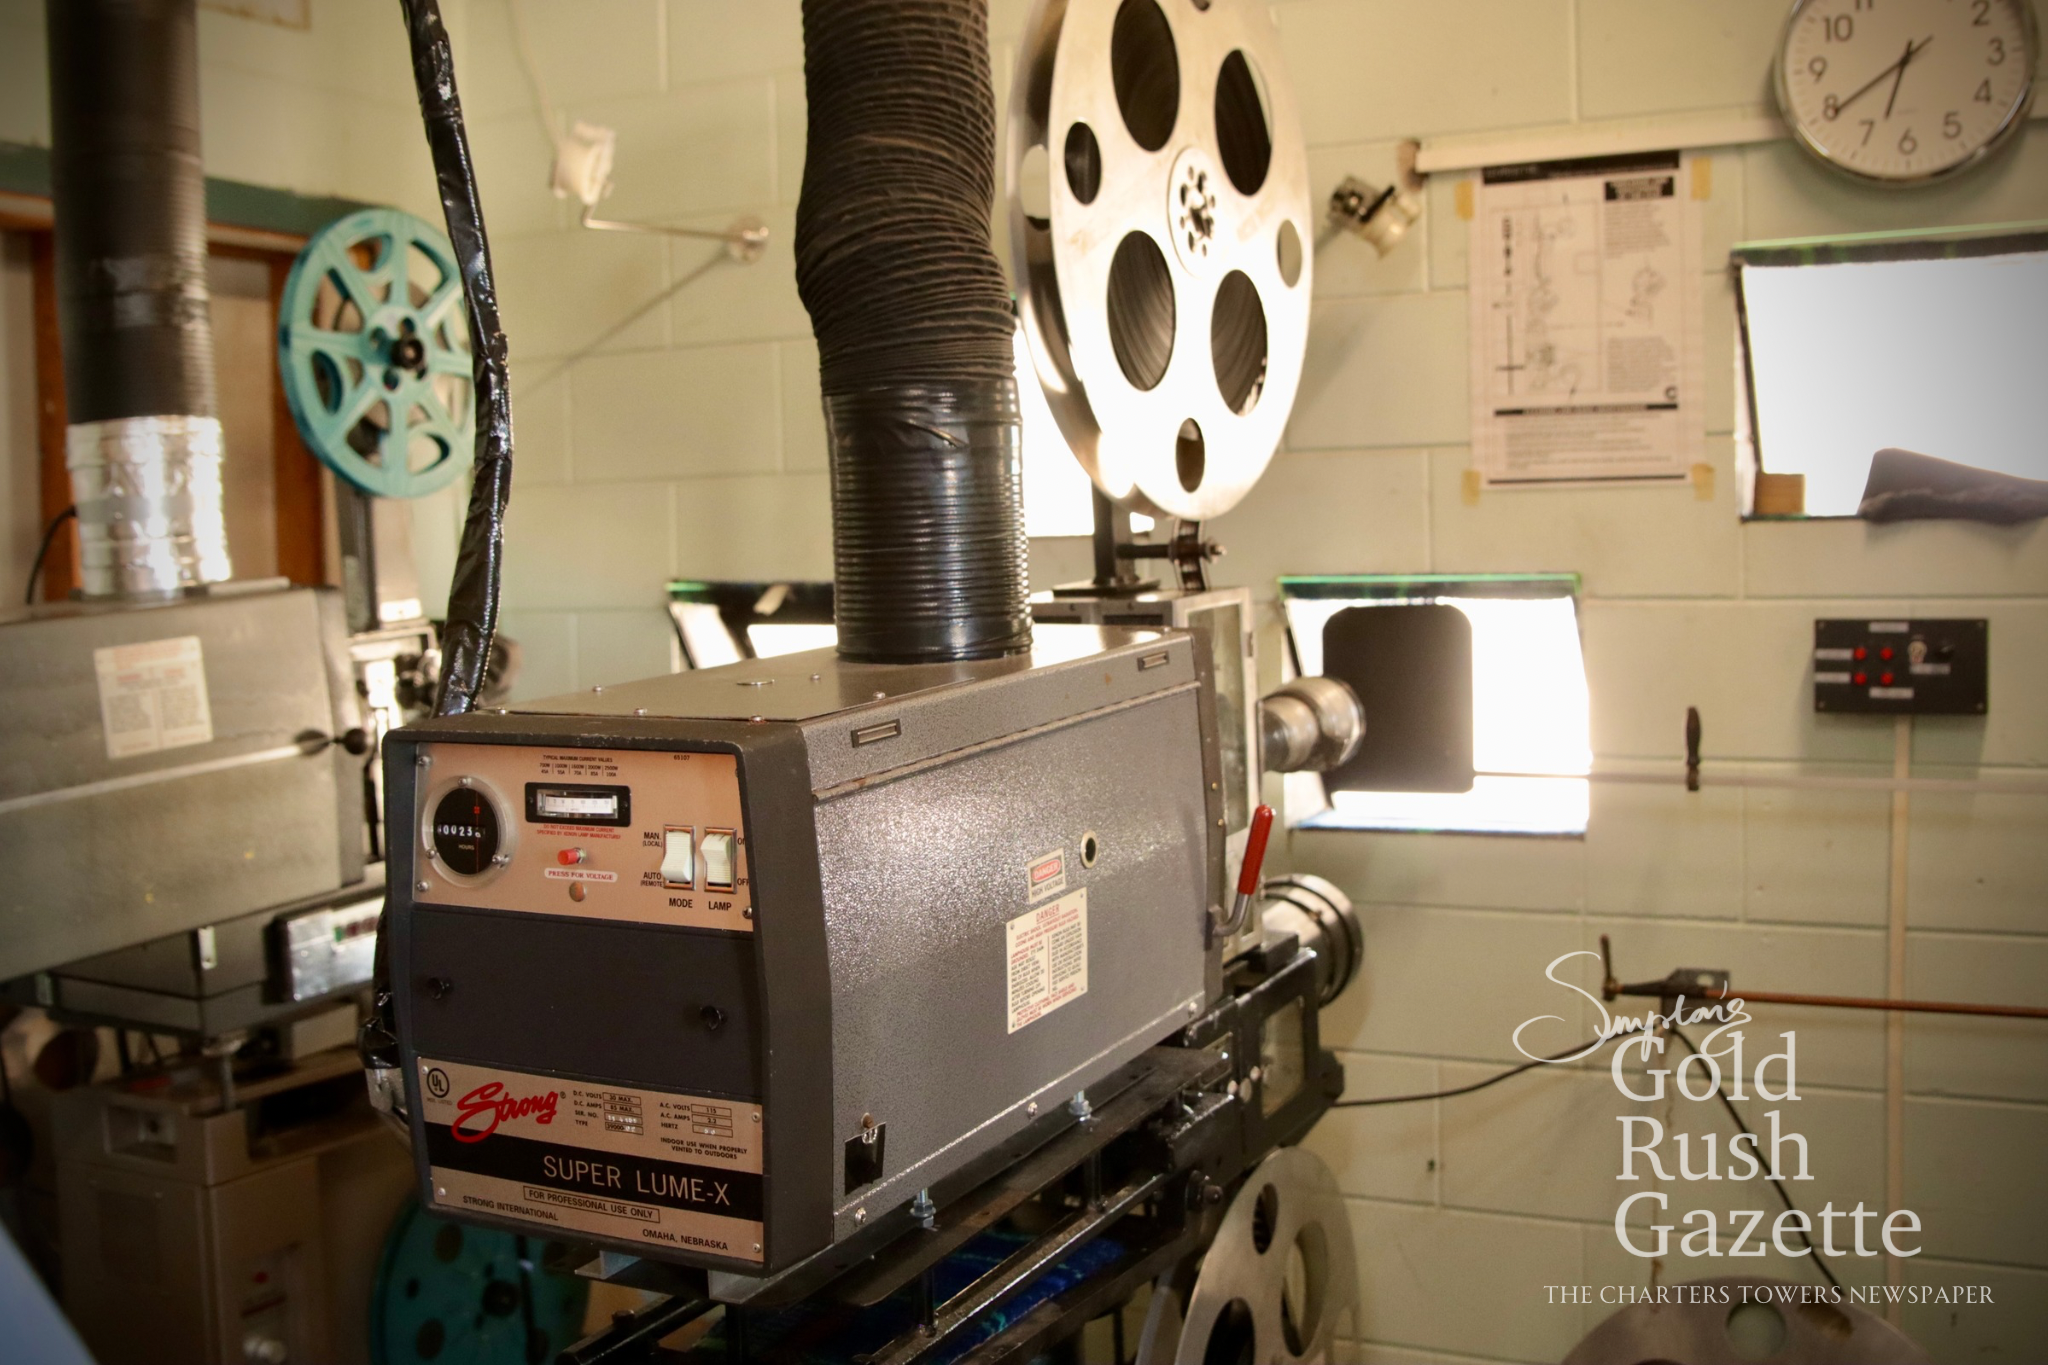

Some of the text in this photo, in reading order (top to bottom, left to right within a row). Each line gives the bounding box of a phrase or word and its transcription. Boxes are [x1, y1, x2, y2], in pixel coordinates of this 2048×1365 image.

[1971, 0, 1990, 27] 2
[1823, 14, 1853, 43] 10
[1987, 37, 2005, 66] 3
[1808, 56, 1828, 83] 9
[1974, 77, 1993, 104] 4
[1823, 93, 1839, 121] 8
[1859, 119, 1875, 146] 7
[1943, 111, 1961, 139] 5
[1898, 128, 1917, 155] 6
[642, 840, 663, 848] (LOCAL)
[643, 832, 661, 840] MAN.
[586, 873, 613, 881] VOLTAGE
[643, 871, 661, 880] AUTO
[668, 897, 732, 911] MODE LAMP
[1035, 904, 1060, 923] DANGER
[431, 1074, 445, 1092] UL
[585, 1091, 602, 1100] VOLTS
[451, 1081, 559, 1144] Strong
[673, 1104, 691, 1112] VOLTS
[660, 1122, 679, 1130] HERTZ
[660, 1137, 684, 1146] INDOOR
[699, 1142, 717, 1150] WHEN
[718, 1145, 748, 1154] PROPERLY
[671, 1145, 693, 1153] VENTED
[704, 1150, 737, 1160] OUTDOORS
[543, 1155, 731, 1206] SUPER LUME-X
[462, 1195, 559, 1221] STRONG INTERNATIONAL
[528, 1189, 654, 1219] FOR PROFESSIONAL USE ONLY
[642, 1228, 729, 1251] OMAHA, NEBRASKA
